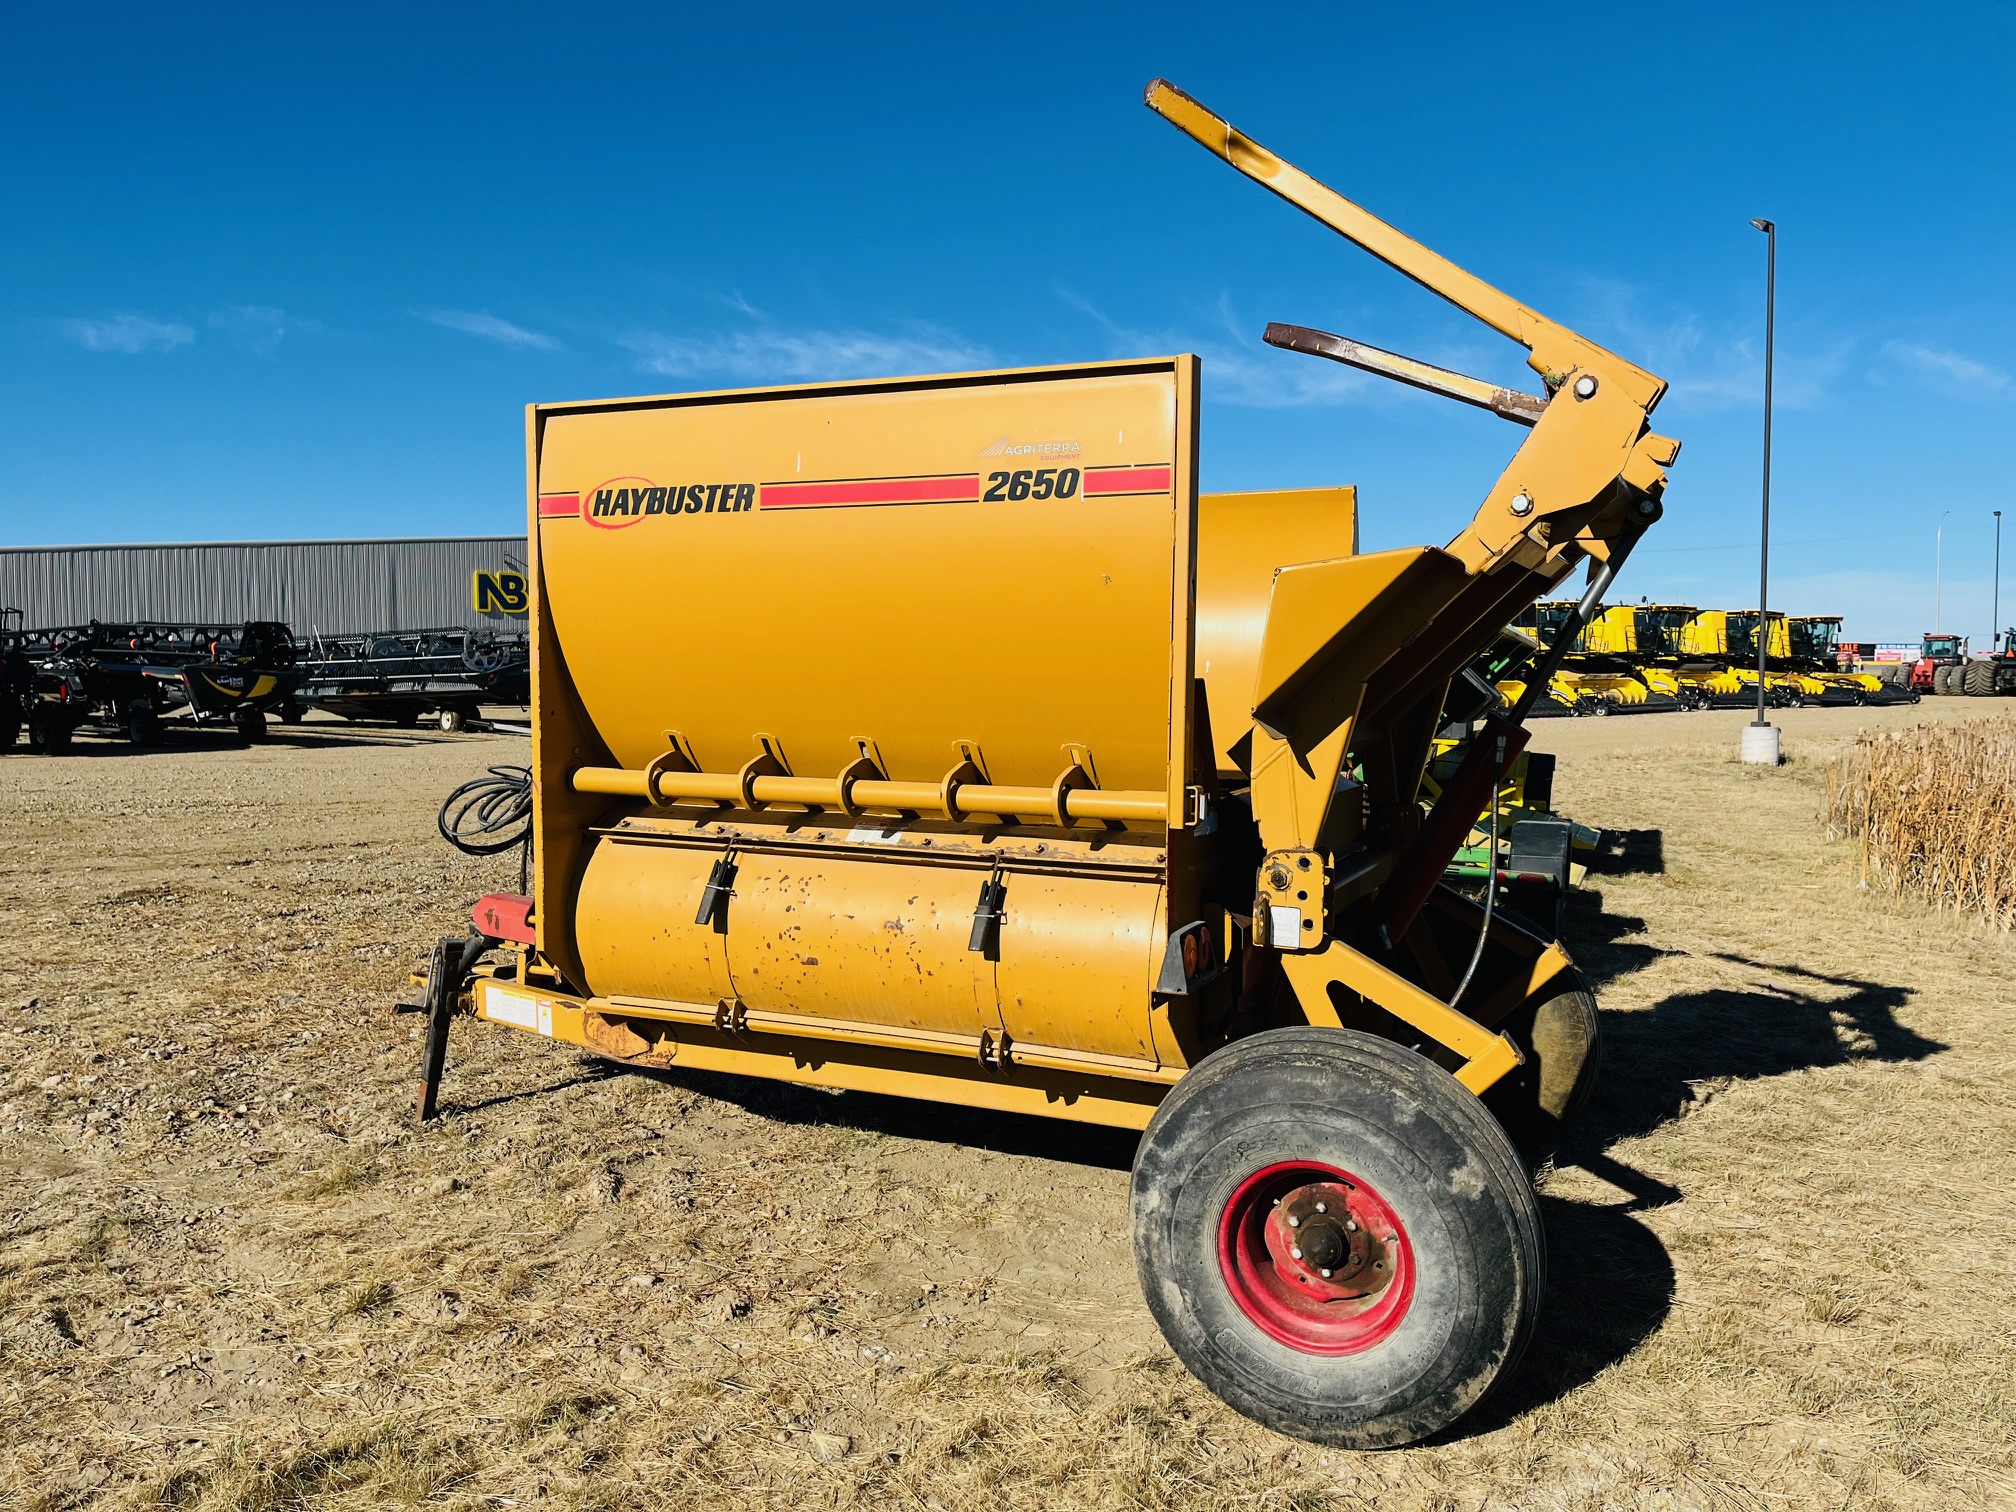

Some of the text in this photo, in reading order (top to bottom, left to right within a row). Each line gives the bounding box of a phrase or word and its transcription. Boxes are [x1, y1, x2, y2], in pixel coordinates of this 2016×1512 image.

[1005, 442, 1080, 456] AGRITERRA
[1040, 453, 1080, 461] EQUIPMENT
[982, 467, 1080, 503] 2650
[591, 482, 755, 518] HAYBUSTER
[1838, 643, 1858, 652] SALE
[1221, 1334, 1313, 1395] TITAN
